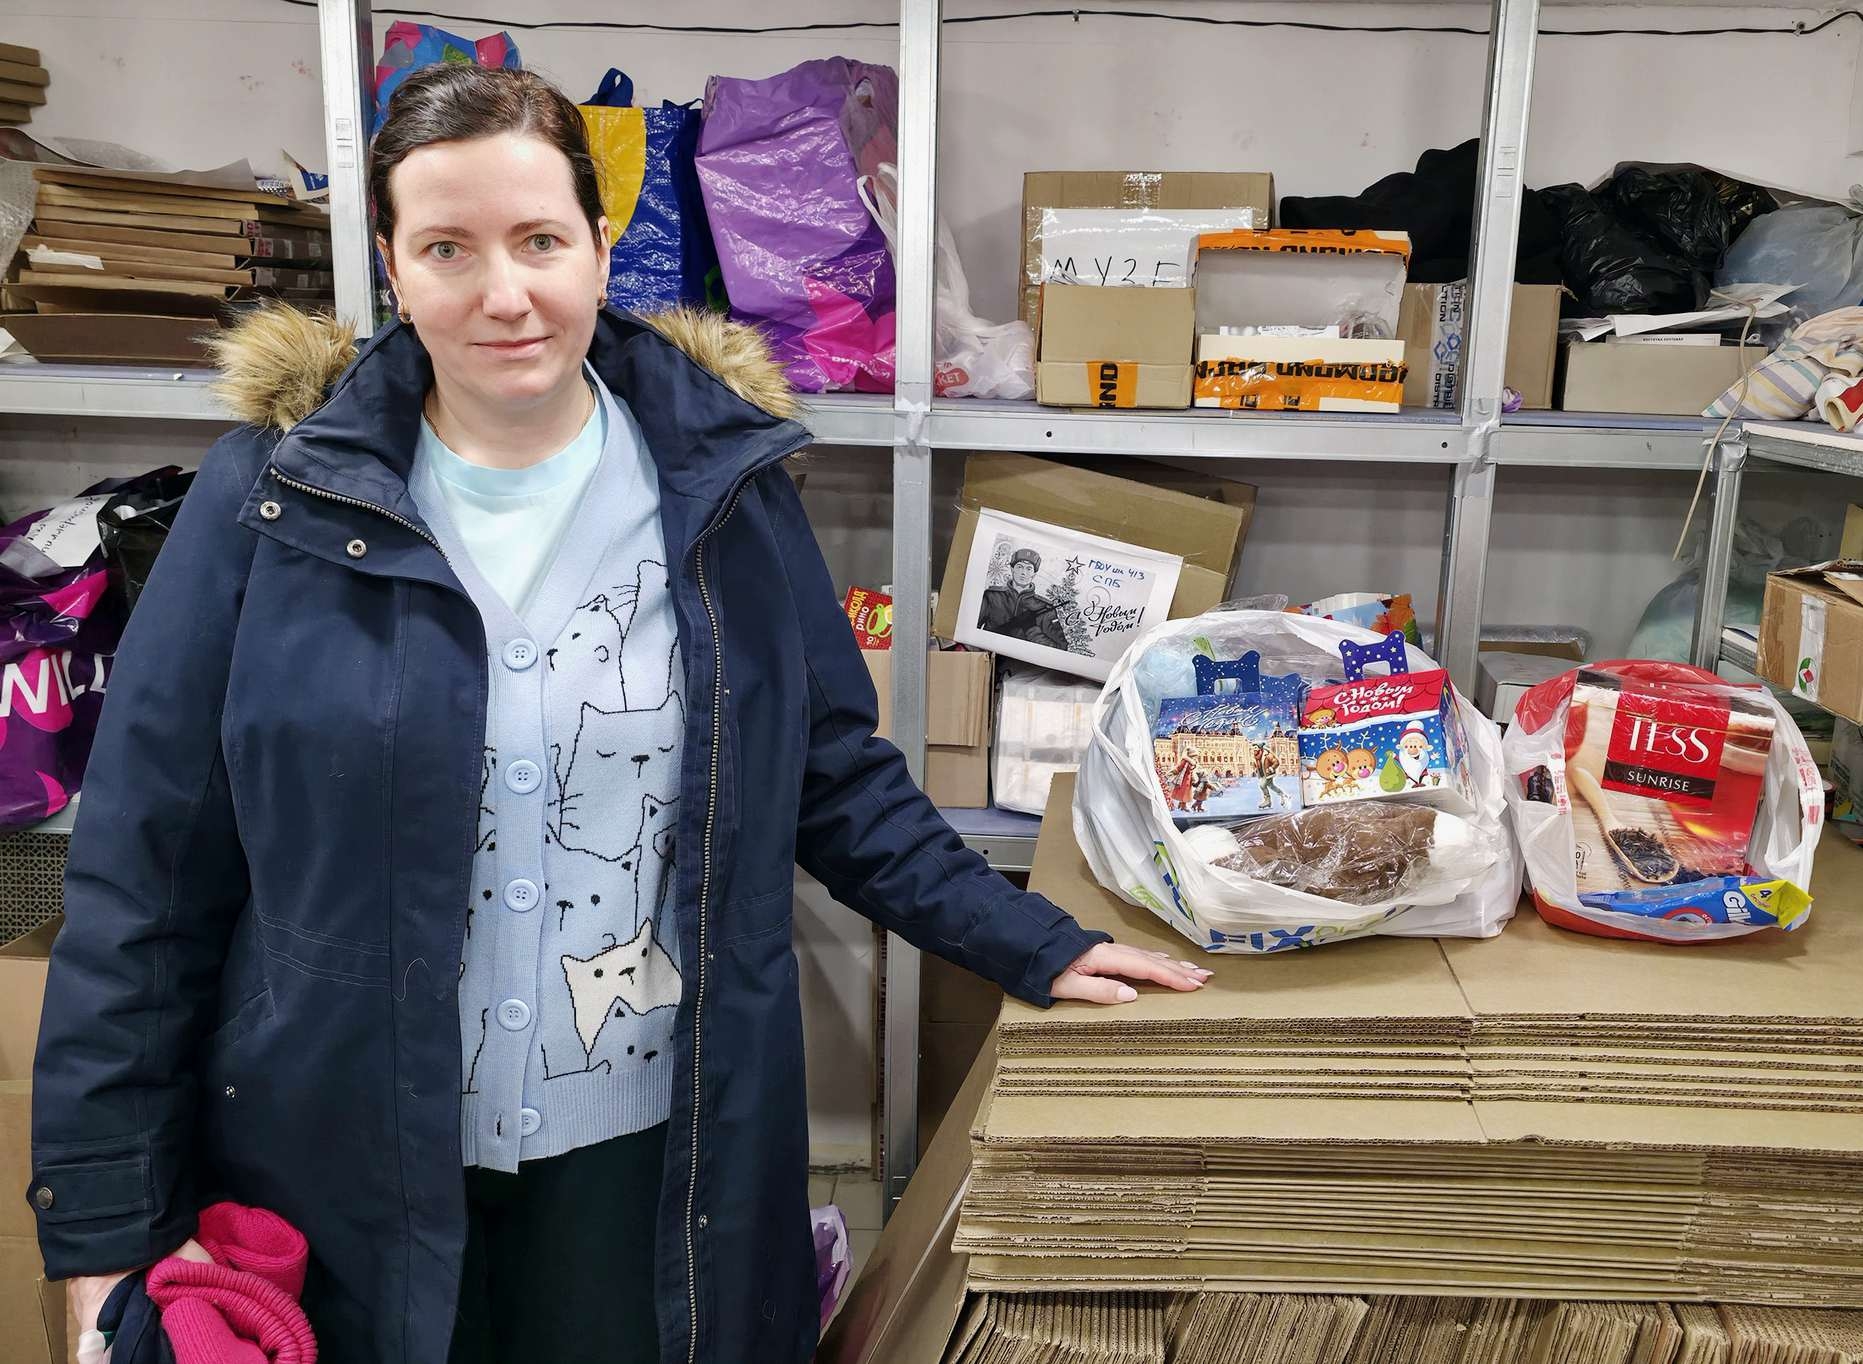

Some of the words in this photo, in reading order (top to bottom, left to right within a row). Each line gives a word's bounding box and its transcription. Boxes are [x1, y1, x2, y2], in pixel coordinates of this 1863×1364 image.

[1083, 601, 1138, 624] Новым
[1332, 691, 1351, 705] С
[1349, 682, 1414, 700] Новым
[1342, 693, 1405, 717] Годом!
[1626, 714, 1710, 764] TESS
[1627, 770, 1691, 792] SUNRISE
[1759, 888, 1773, 899] 4
